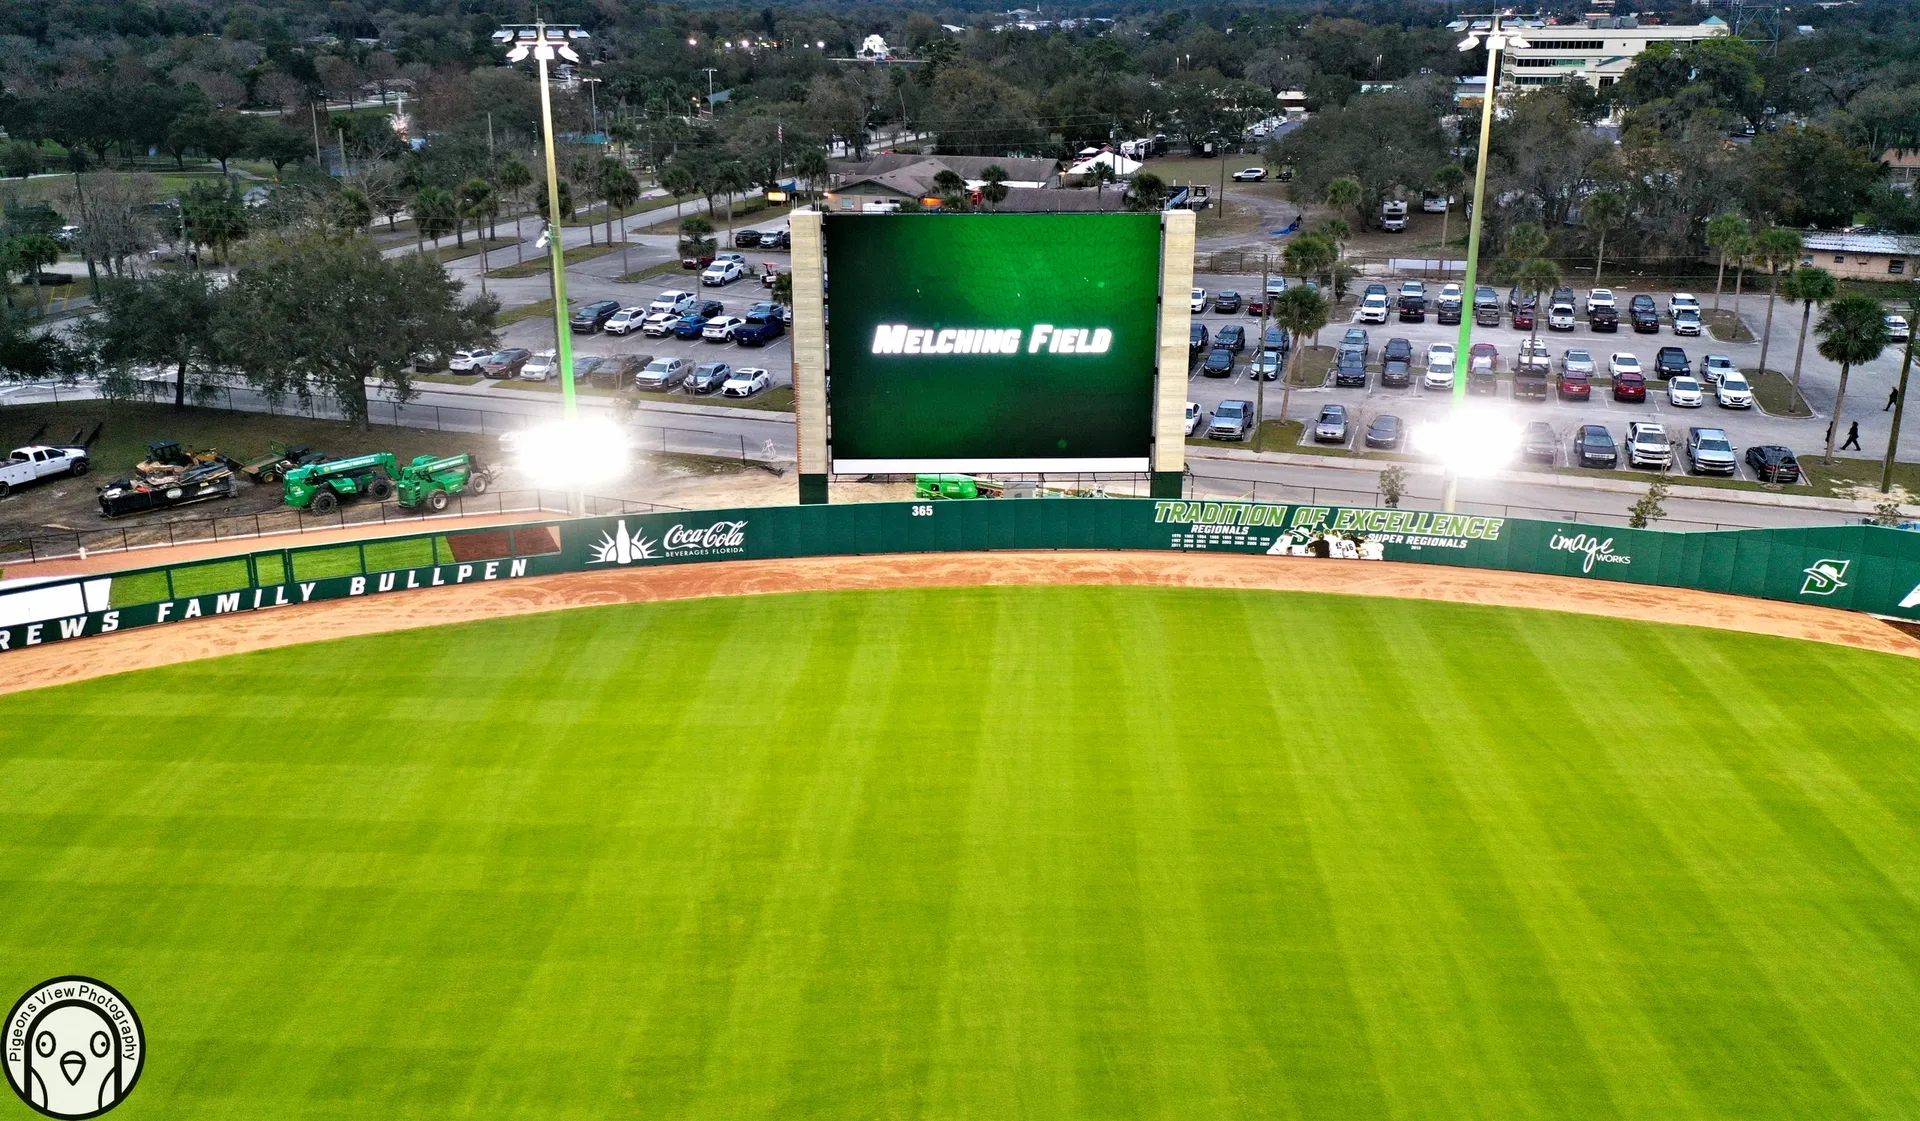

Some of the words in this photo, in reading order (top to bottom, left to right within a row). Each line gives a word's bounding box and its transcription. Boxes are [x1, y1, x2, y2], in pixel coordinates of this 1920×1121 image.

[912, 505, 933, 517] 365
[1154, 501, 1288, 527] TRADITION
[1291, 506, 1330, 529] OF
[1333, 506, 1504, 541] EXCELLENCE
[663, 520, 749, 550] Coca-Cola
[1191, 524, 1250, 535] REGIONALS
[1368, 533, 1404, 543] SUPER
[1406, 535, 1468, 549] REGIONALS
[665, 549, 709, 557] BEVERAGES
[1549, 528, 1615, 574] image
[1595, 553, 1631, 564] WORKS
[157, 582, 316, 623] FAMILY
[349, 558, 527, 596] BULLPEN
